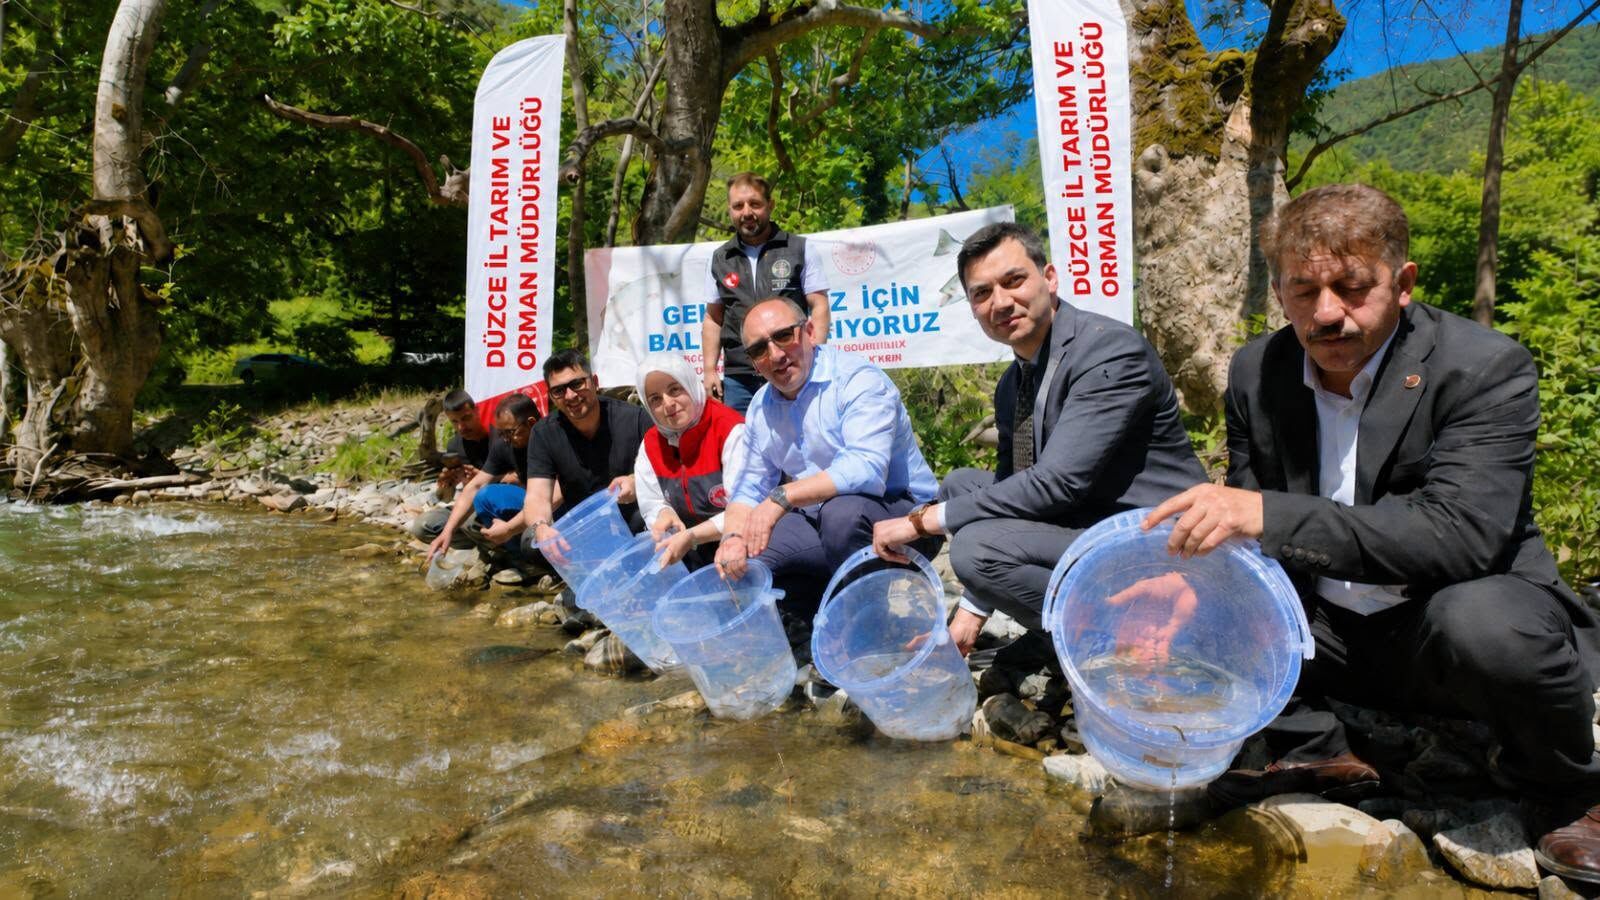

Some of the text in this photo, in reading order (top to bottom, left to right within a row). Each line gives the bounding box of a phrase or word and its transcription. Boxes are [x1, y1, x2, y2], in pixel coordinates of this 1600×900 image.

[483, 115, 511, 368] DÜZCE İL TARIM VE
[517, 96, 543, 371] ORMAN MÜDÜRLÜĞÜ
[1054, 41, 1091, 296] DÜZCE İL TARIM VE
[1079, 22, 1119, 298] ORMAN MÜDÜRLÜĞÜ
[648, 311, 941, 353] BAL IYORUZ
[861, 282, 920, 314] İÇİN
